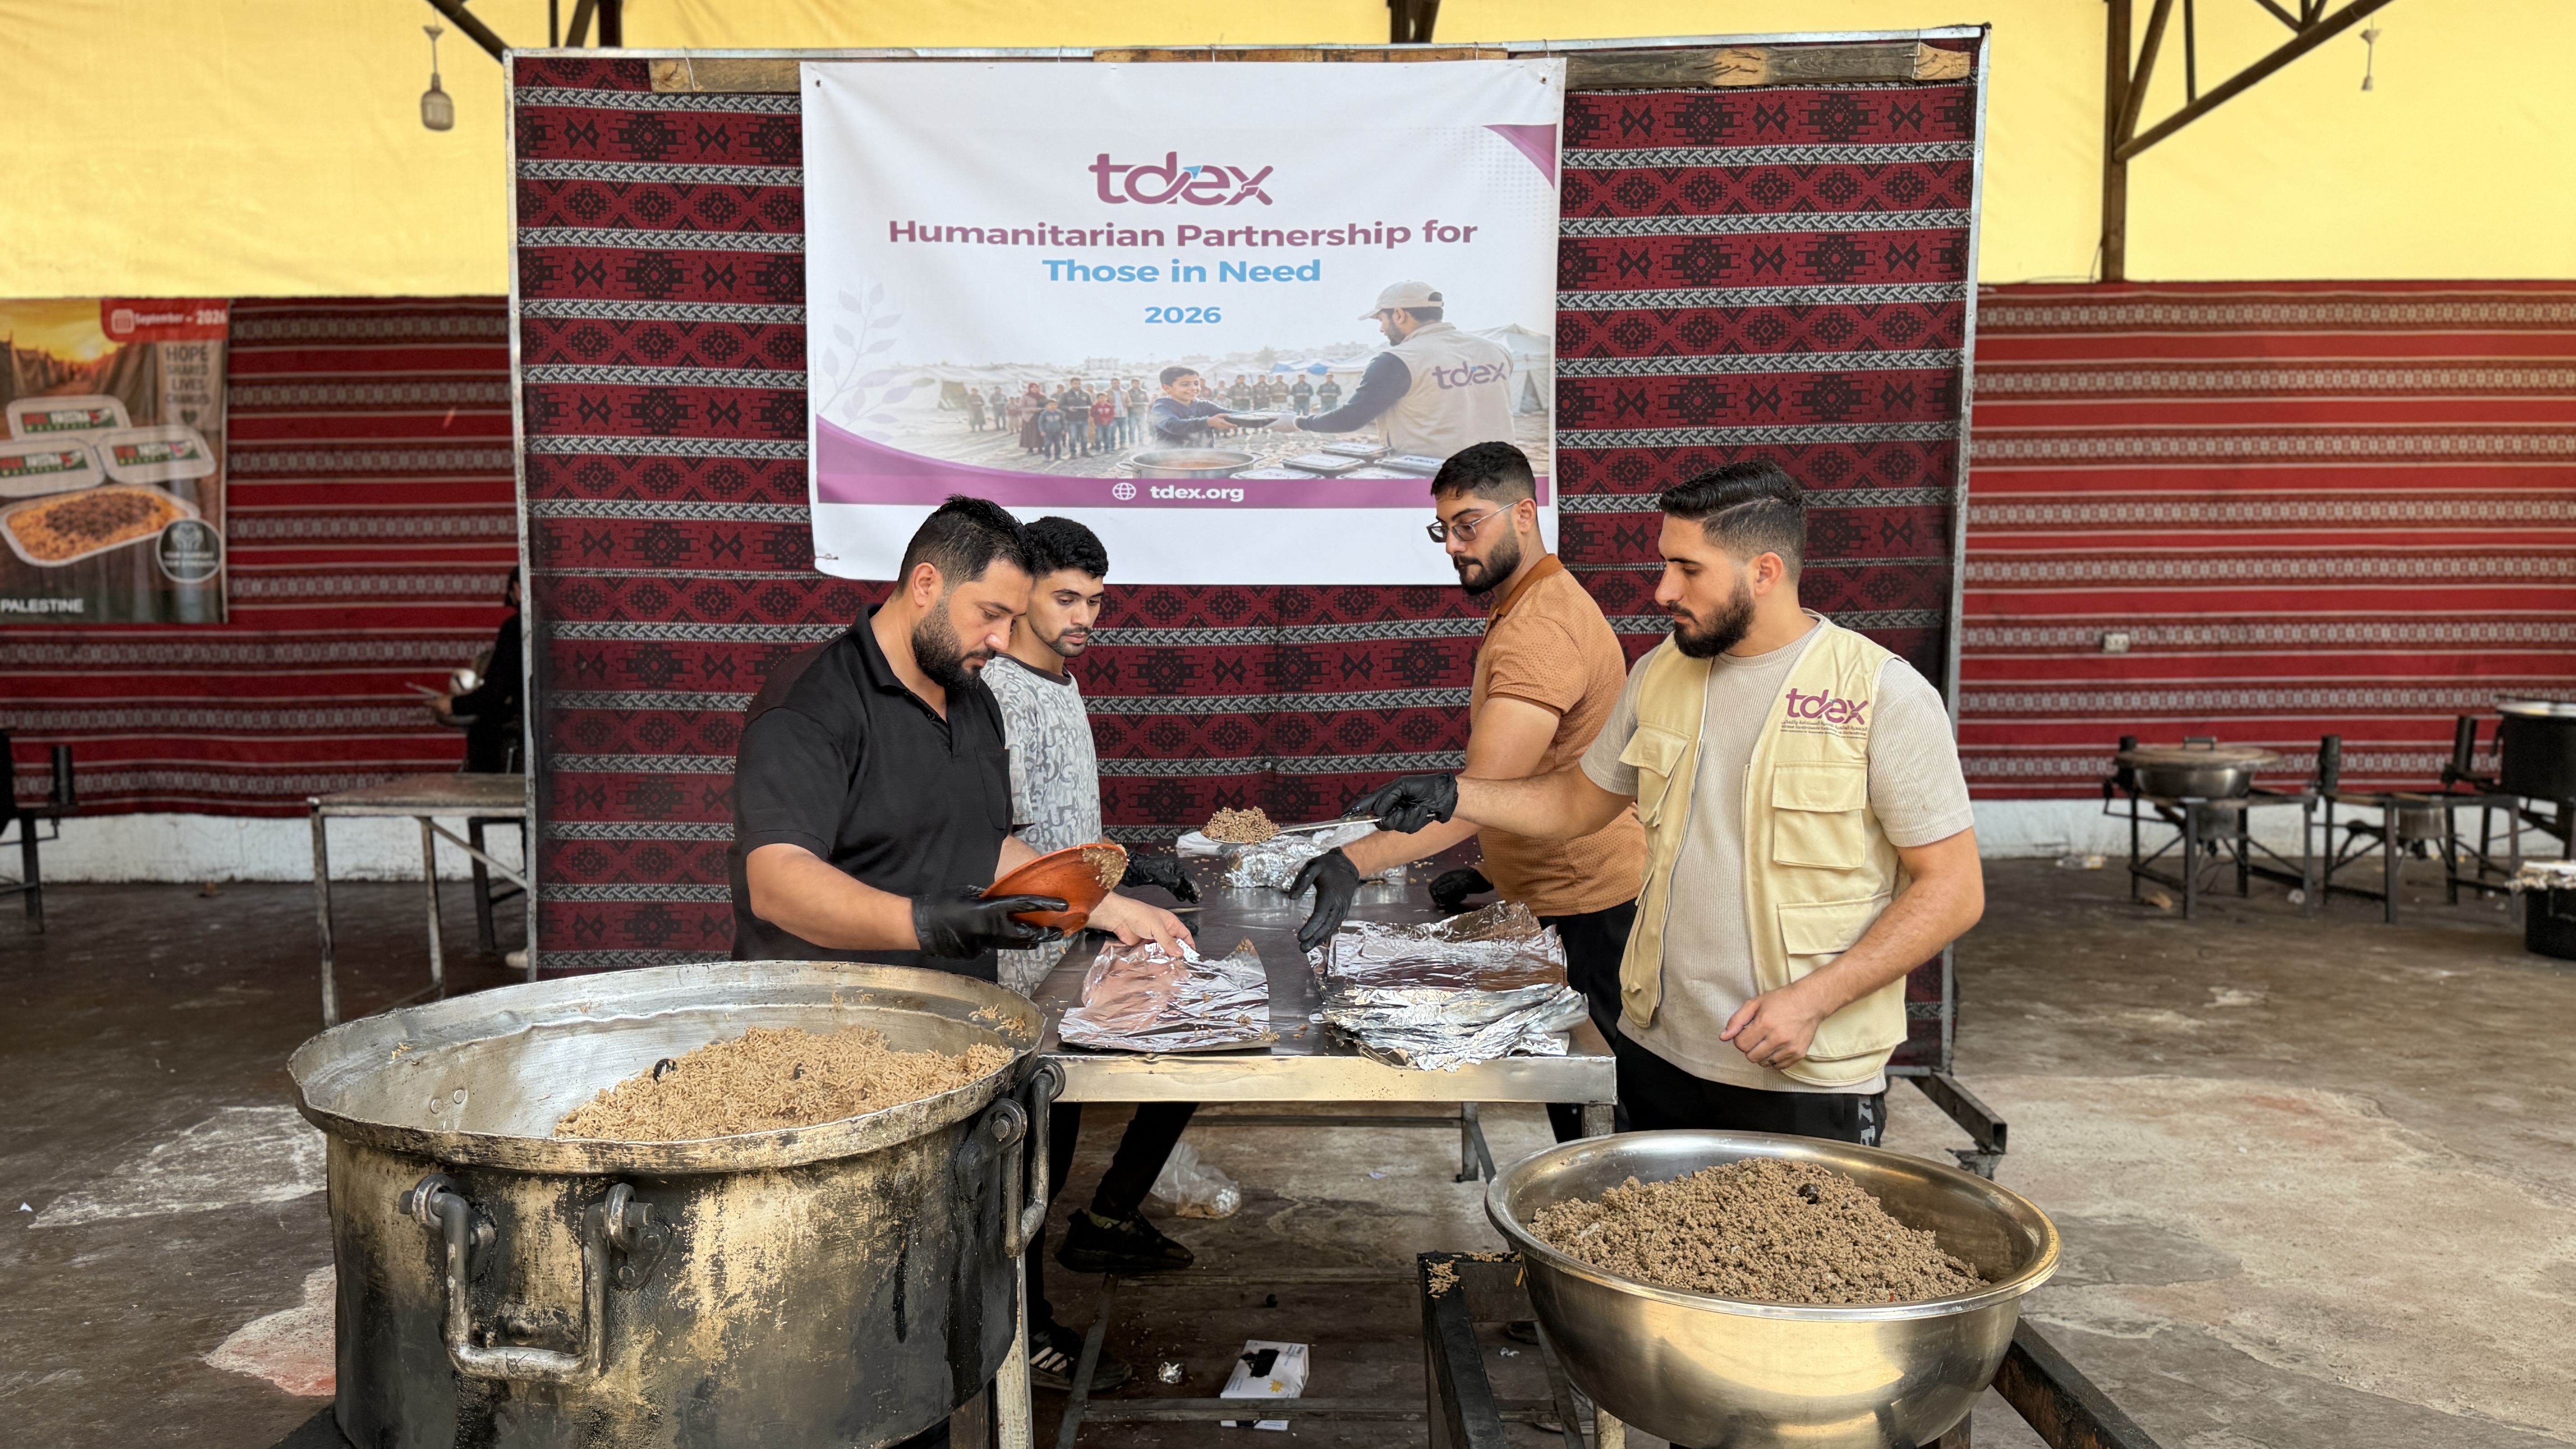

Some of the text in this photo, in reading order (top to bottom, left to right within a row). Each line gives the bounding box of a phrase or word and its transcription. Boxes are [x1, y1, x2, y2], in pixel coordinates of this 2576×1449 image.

[1088, 152, 1273, 205] tdex
[889, 220, 1477, 249] Humanitarian Partnership for
[1042, 258, 1320, 282] Those in Need
[136, 313, 183, 326] September
[196, 309, 227, 325] 2026
[1145, 307, 1221, 324] 2026
[166, 345, 208, 361] HOPE
[1432, 361, 1506, 389] tdex
[172, 378, 206, 391] LIVES
[1150, 485, 1244, 502] tdex.org
[0, 598, 84, 613] PALESTINE
[1786, 688, 1868, 725] tdex
